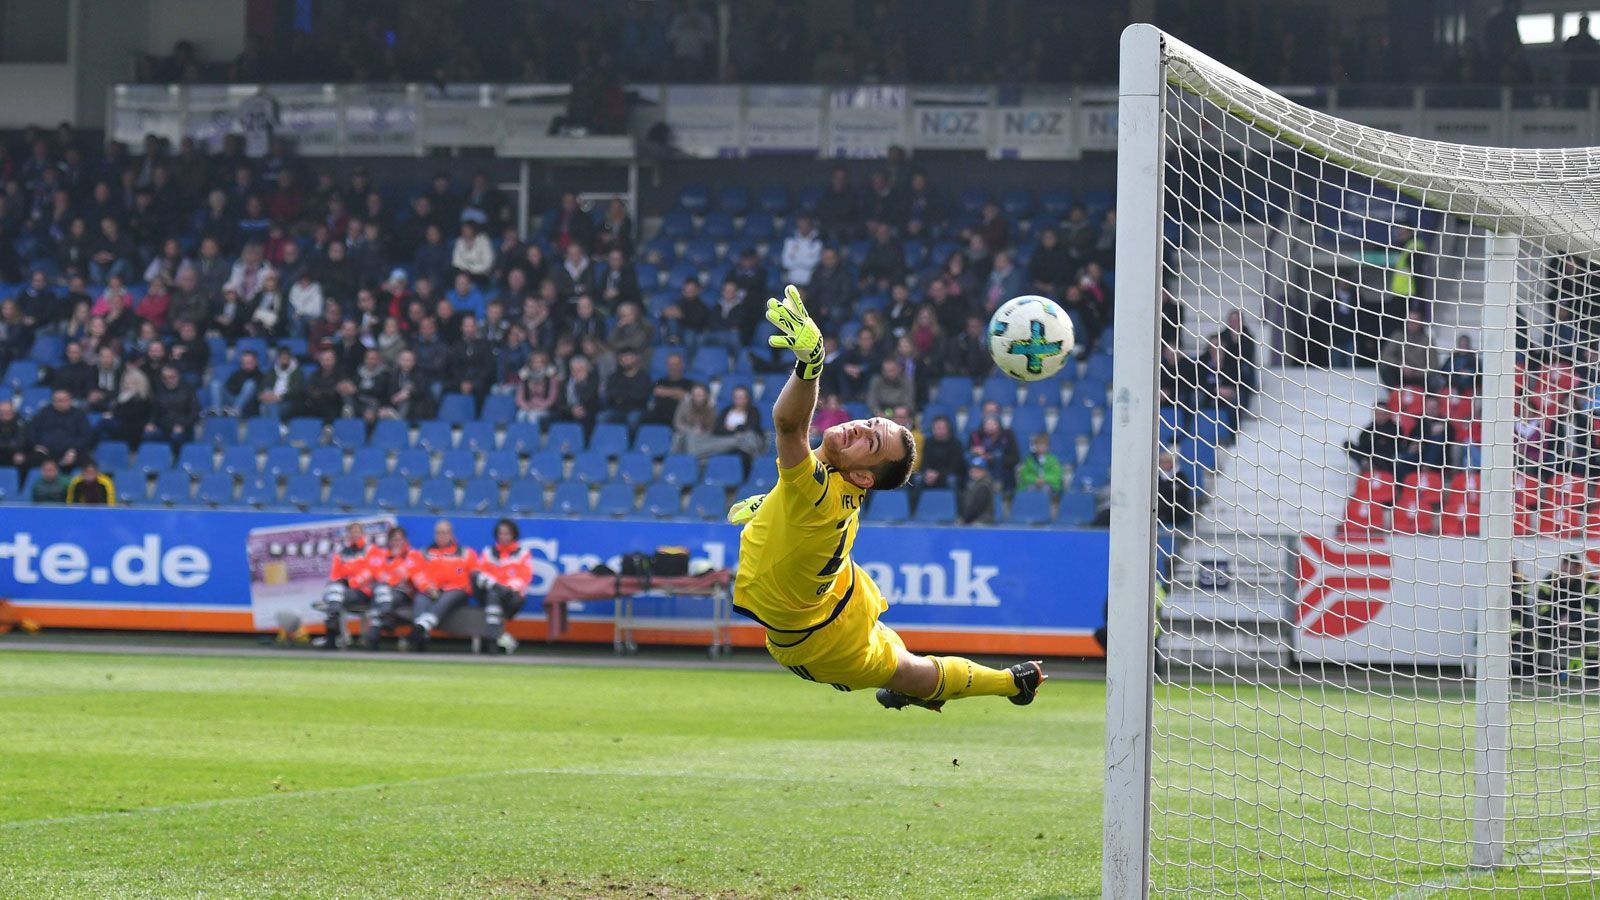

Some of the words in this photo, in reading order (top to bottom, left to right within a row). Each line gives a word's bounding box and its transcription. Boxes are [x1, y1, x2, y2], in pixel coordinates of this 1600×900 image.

[920, 111, 979, 135] NOZ
[1005, 111, 1064, 136] NOZ
[840, 494, 857, 510] VFL
